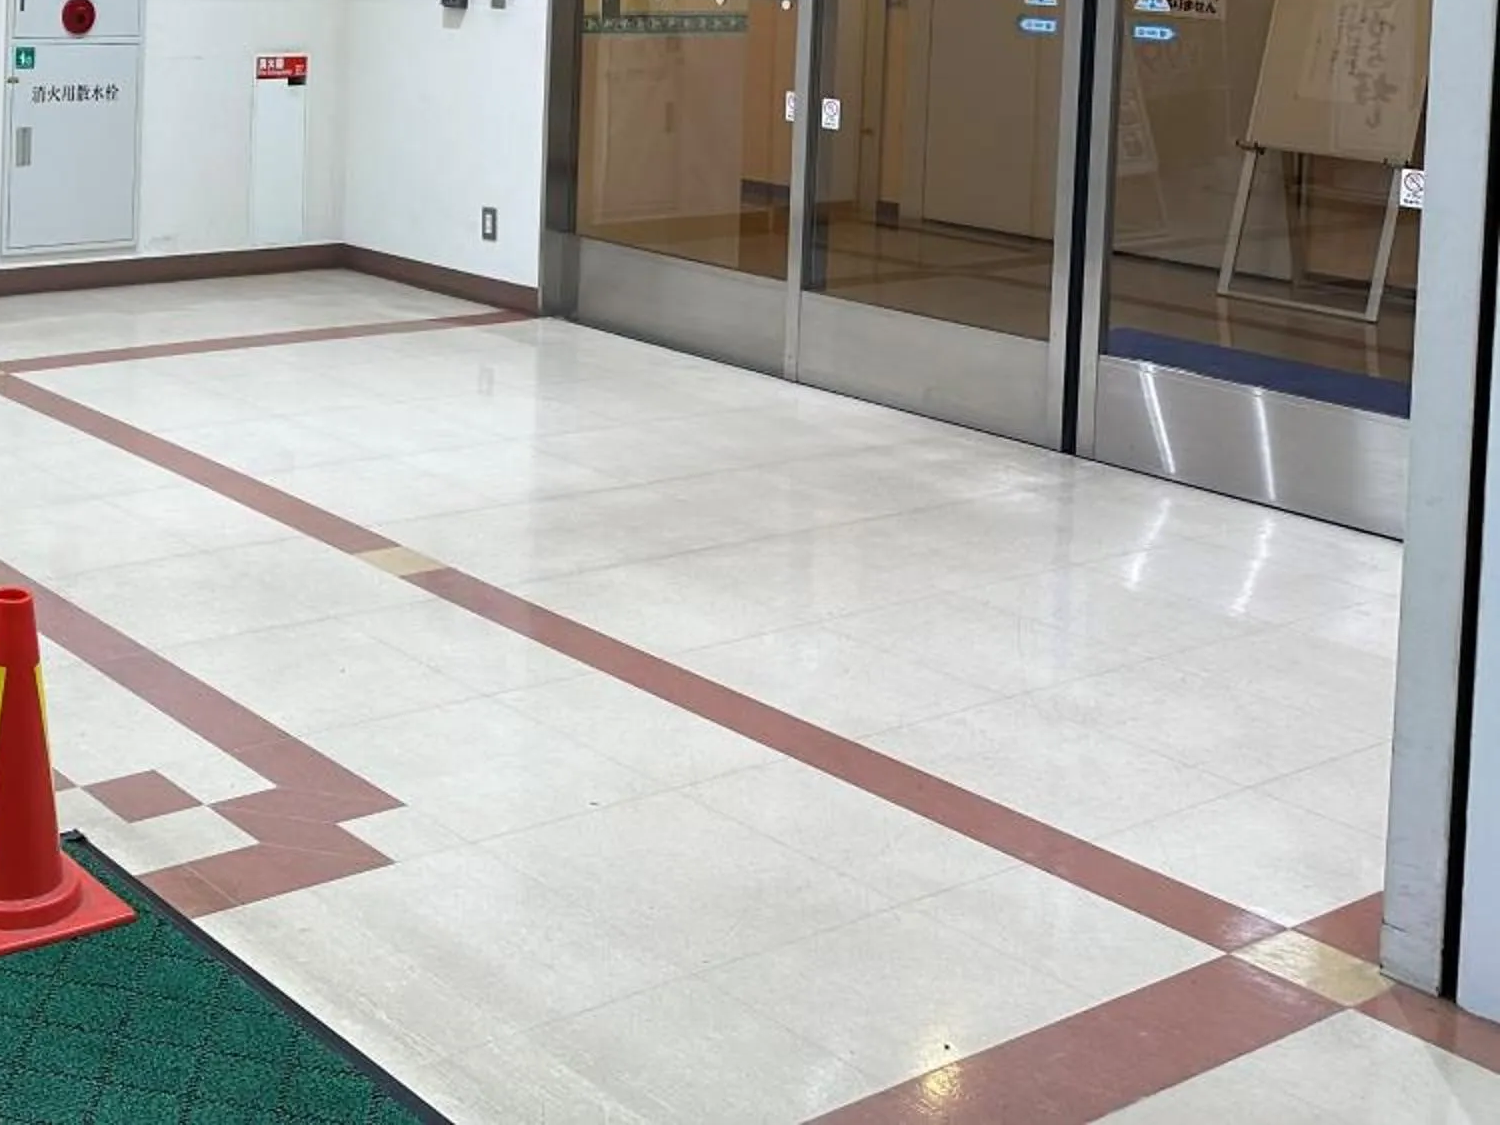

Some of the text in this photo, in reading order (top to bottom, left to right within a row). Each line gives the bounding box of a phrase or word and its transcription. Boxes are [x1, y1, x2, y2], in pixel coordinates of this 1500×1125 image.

[31, 83, 120, 103] 消火用散水栓
